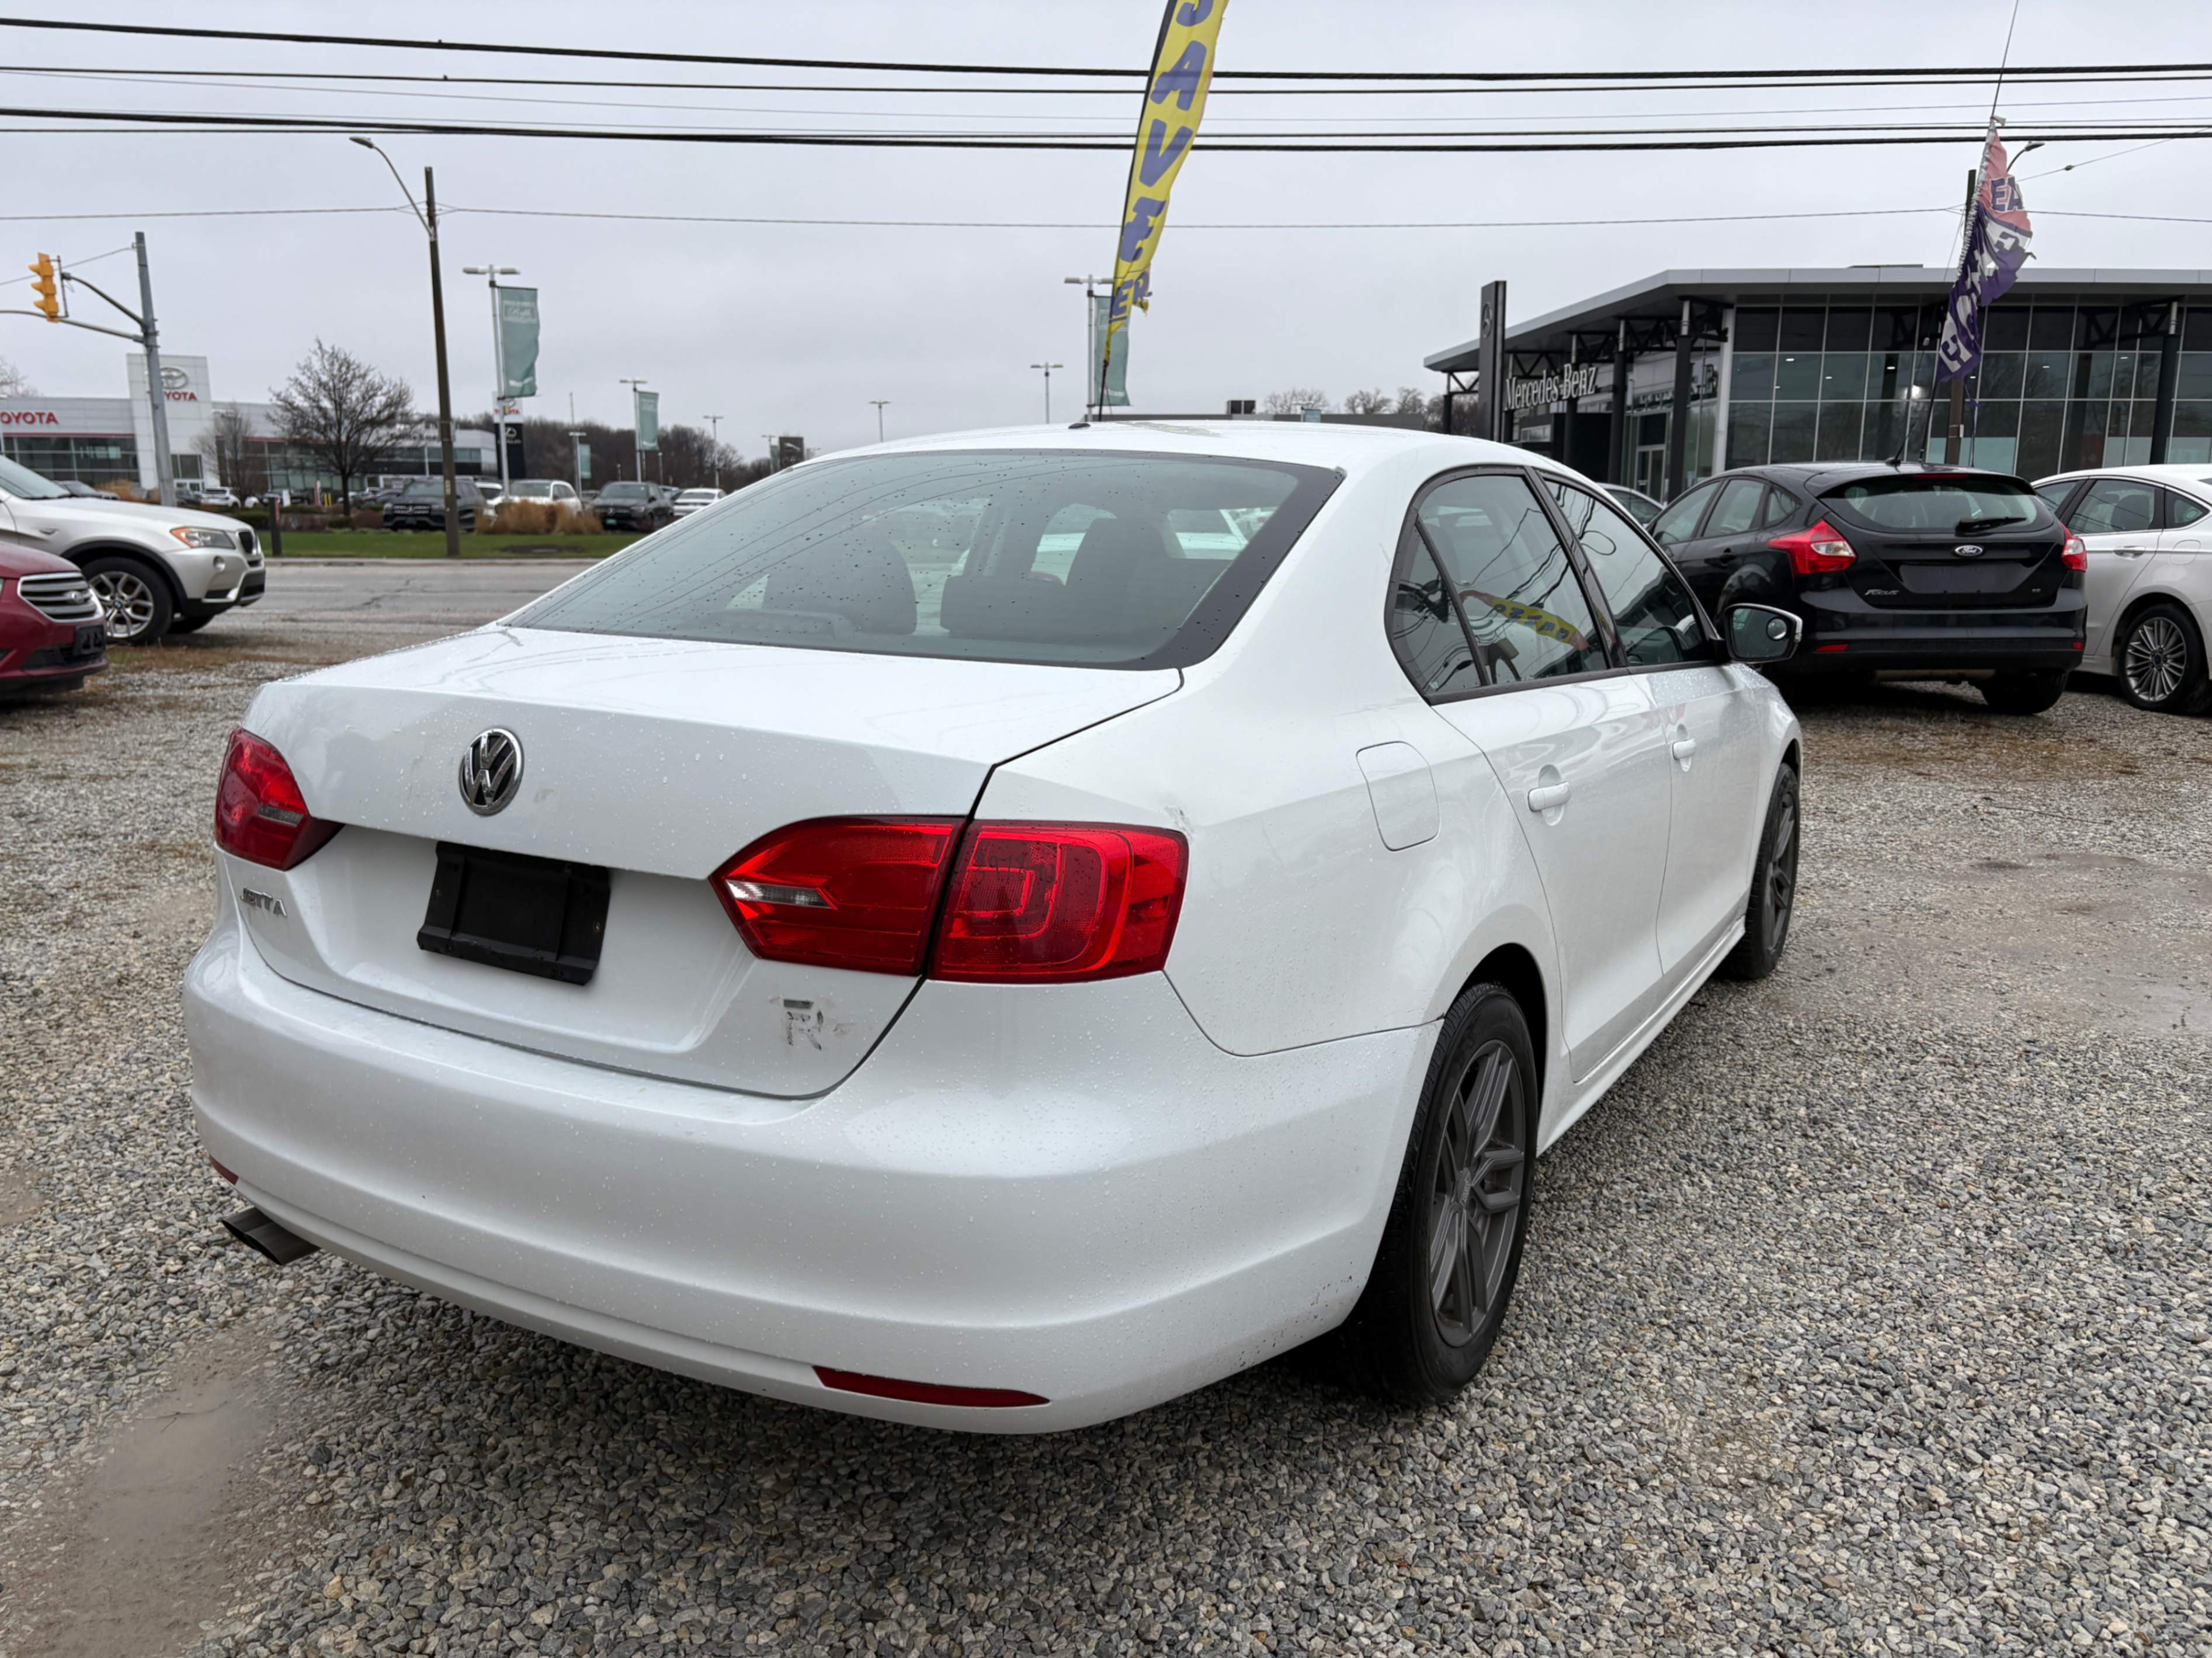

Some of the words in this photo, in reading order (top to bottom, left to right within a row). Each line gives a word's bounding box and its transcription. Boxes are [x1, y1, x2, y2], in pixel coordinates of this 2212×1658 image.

[164, 391, 197, 401] YOTA
[1504, 363, 1598, 411] Mercedes-Benz
[0, 411, 58, 425] OYOTA
[240, 887, 287, 917] JETTA
